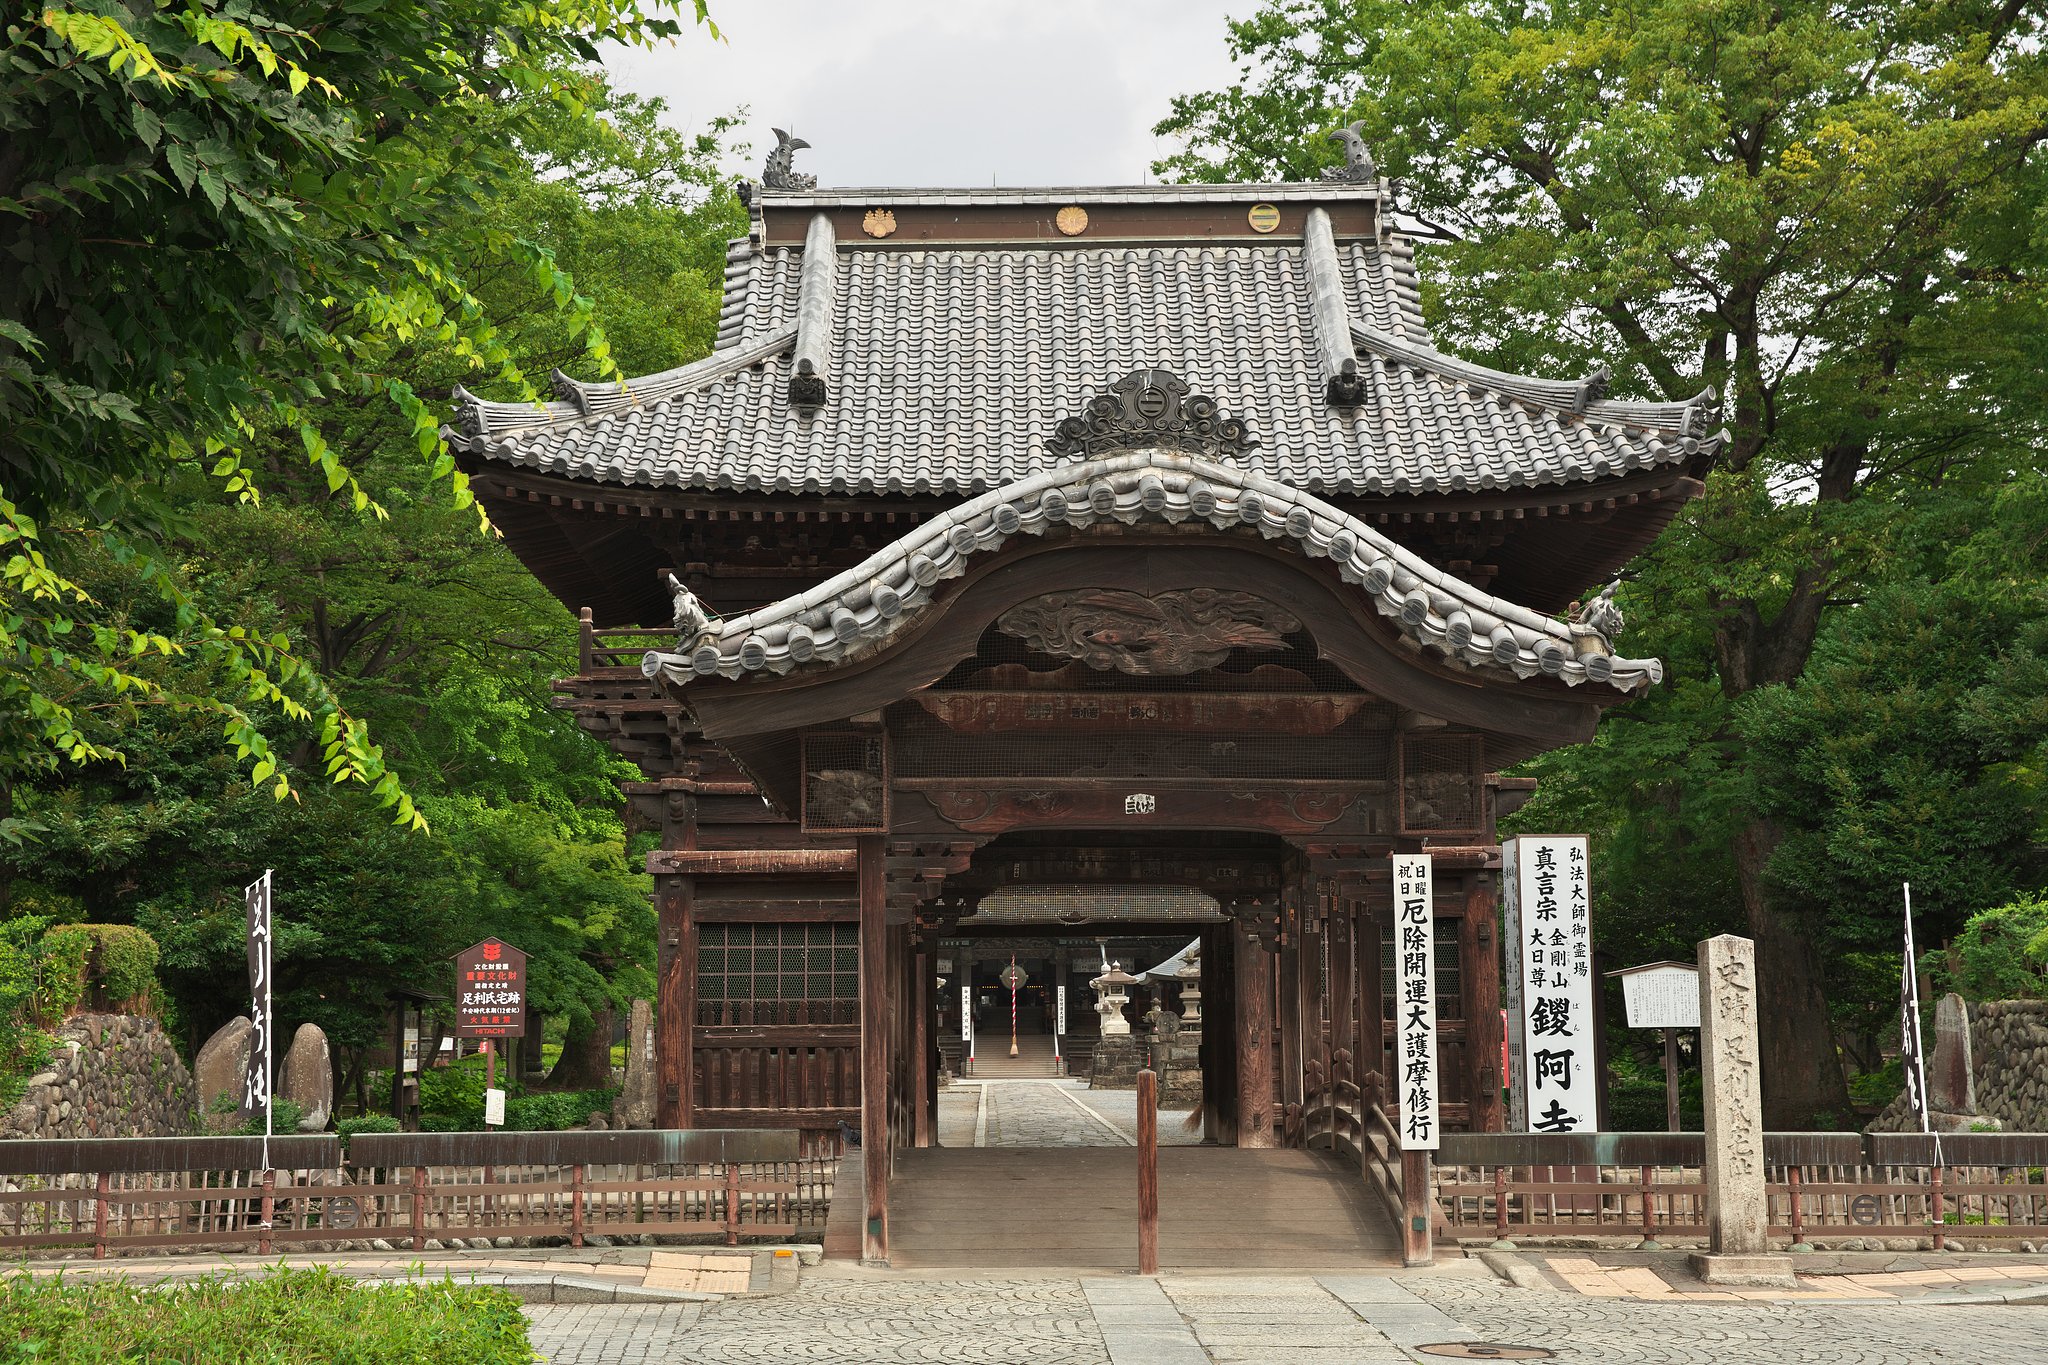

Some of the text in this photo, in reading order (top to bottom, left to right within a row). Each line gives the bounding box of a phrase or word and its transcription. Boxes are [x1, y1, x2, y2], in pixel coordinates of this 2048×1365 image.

[1398, 865, 1412, 895] 祝日
[1415, 865, 1427, 895] 日曜
[1534, 846, 1558, 922] 真言宗
[1569, 846, 1588, 977] 弘法大師御霊場
[466, 971, 517, 981] 重要文化財
[1529, 928, 1547, 989] 大日尊
[1549, 928, 1568, 989] 金剛山
[462, 991, 521, 1005] 足利氏宅跡
[1401, 898, 1433, 1142] 厄除開運大護摩修行
